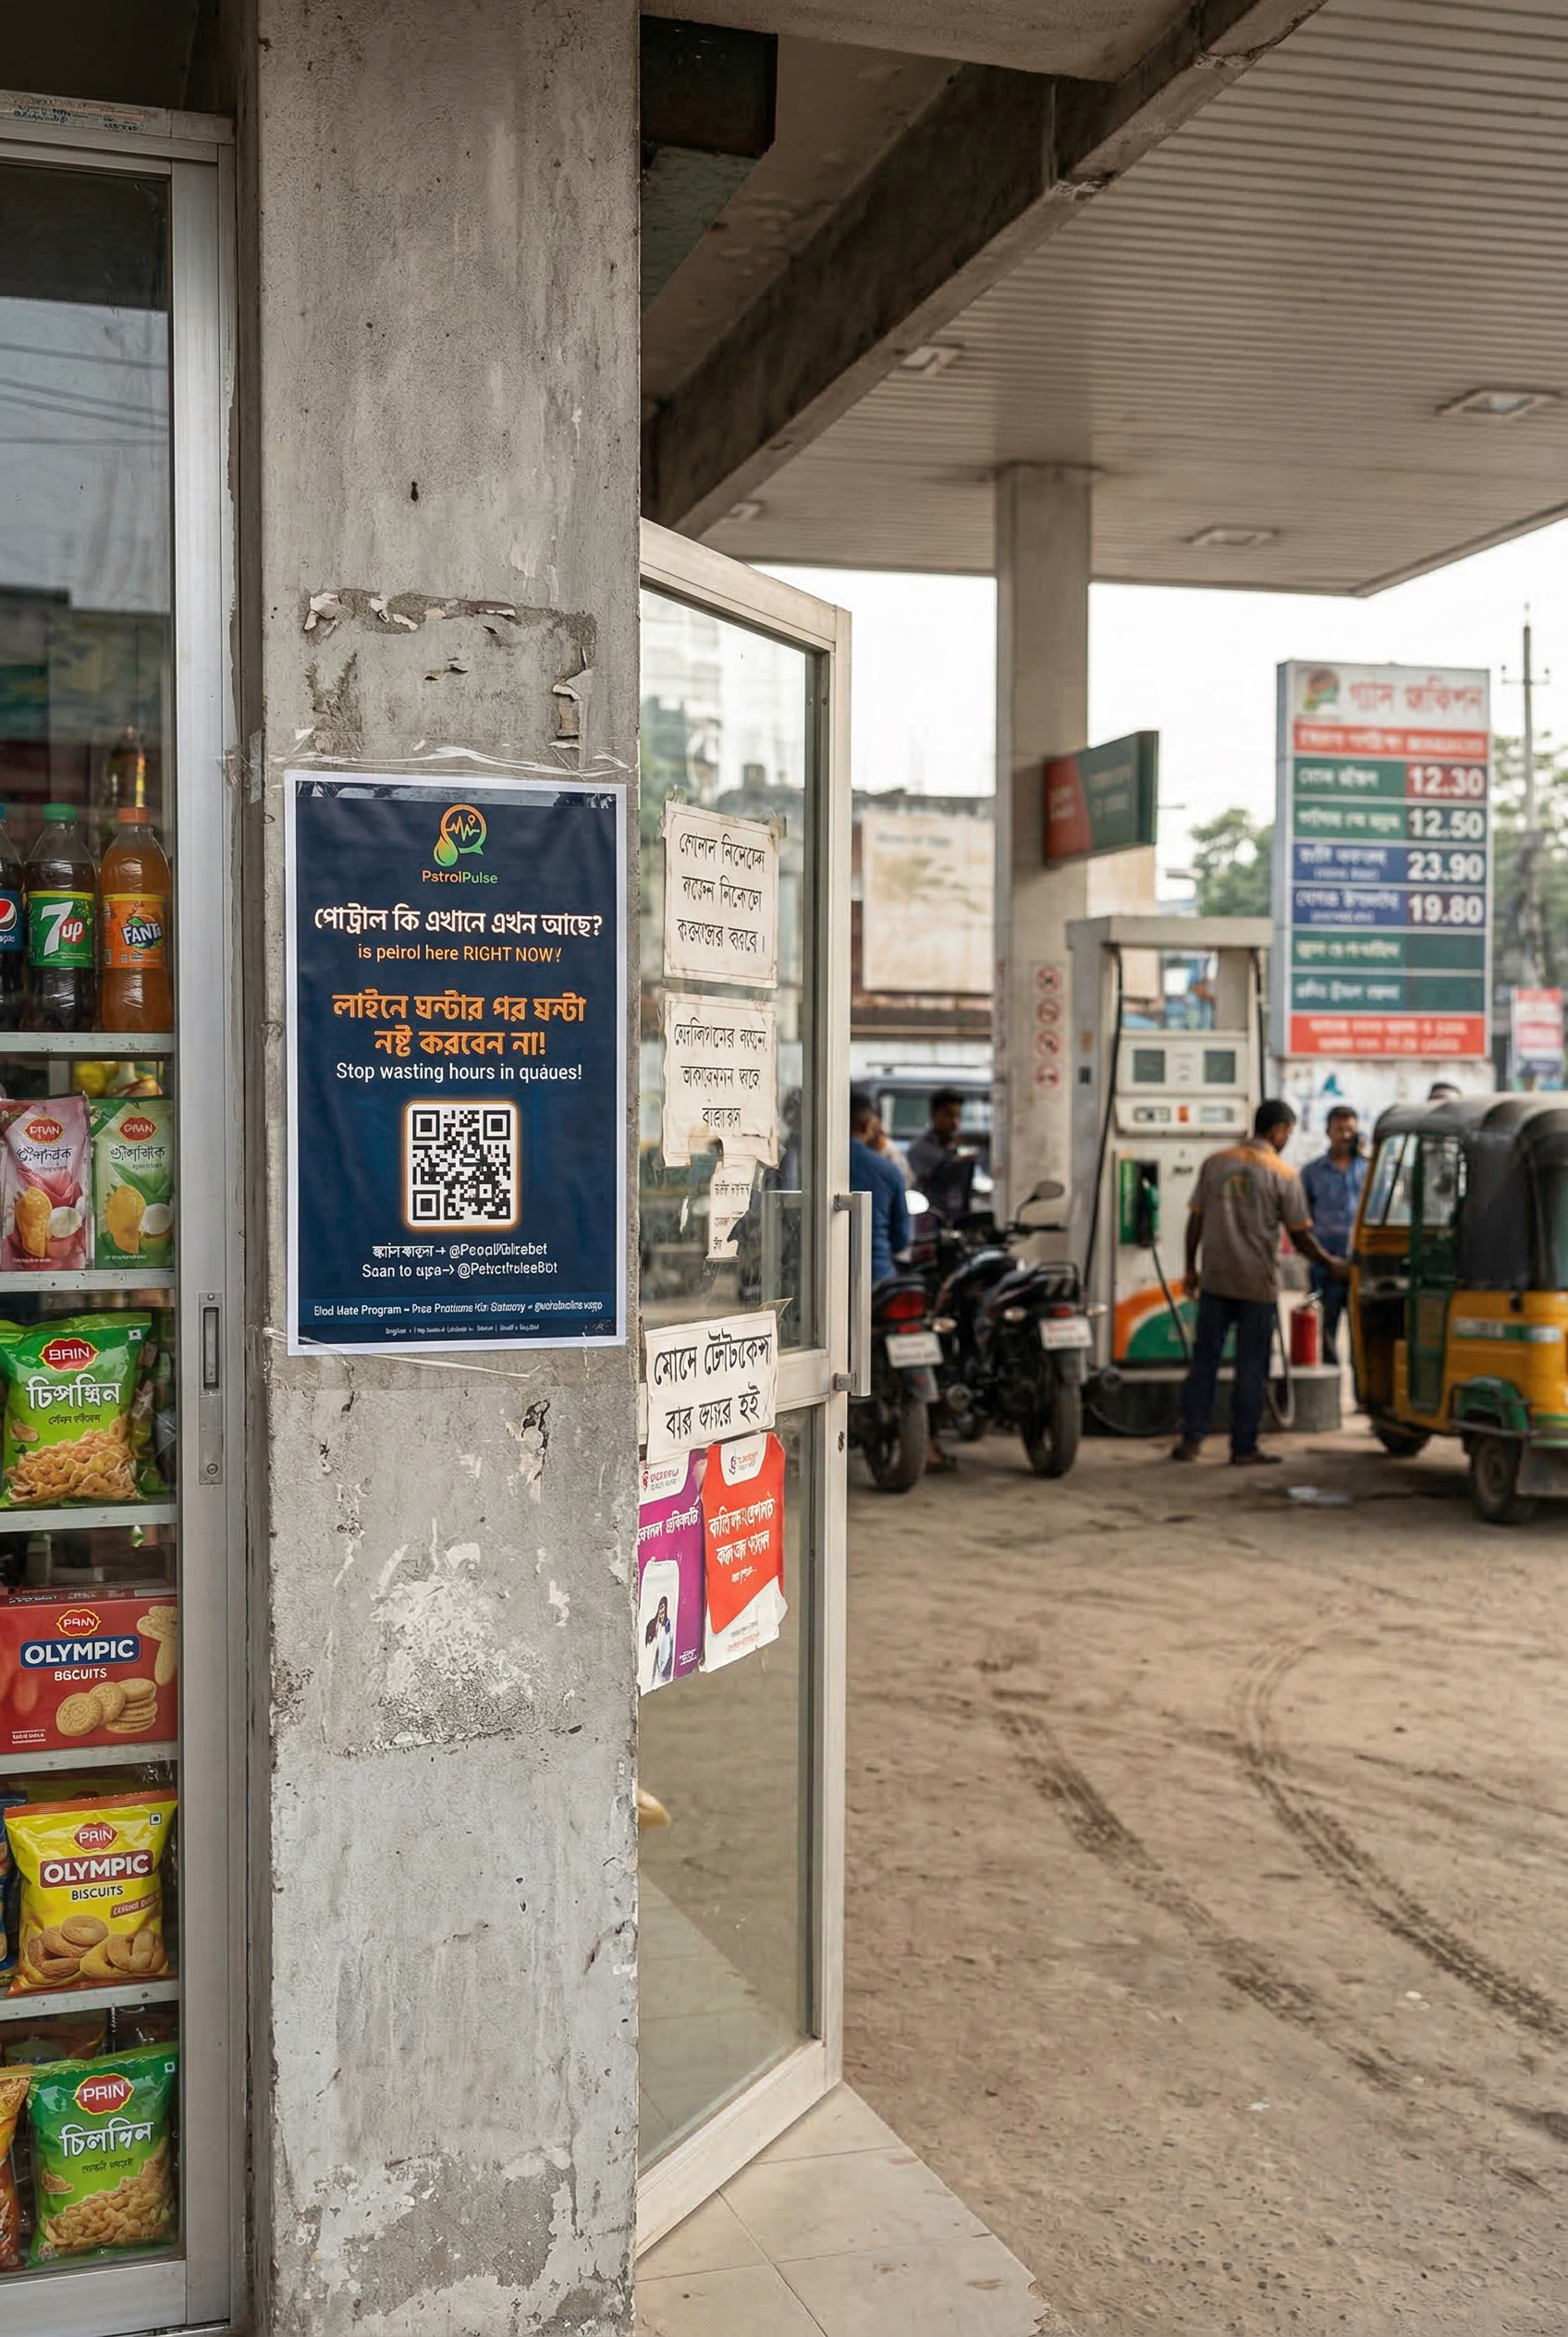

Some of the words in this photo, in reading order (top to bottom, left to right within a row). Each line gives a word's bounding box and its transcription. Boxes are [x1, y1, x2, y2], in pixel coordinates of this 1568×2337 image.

[1408, 765, 1485, 797] 12.30
[1408, 808, 1484, 839] 12.50
[1407, 851, 1484, 883] 23.90
[392, 903, 421, 931] কি
[425, 908, 485, 934] এখানে
[491, 911, 535, 935] এখন
[542, 913, 603, 937] আছে?
[1407, 894, 1484, 924] 19.80
[425, 945, 459, 960] here
[463, 947, 511, 961] RIGHT
[332, 988, 409, 1020] লাইনে
[493, 996, 527, 1022] পর
[419, 1031, 506, 1056] করবেন
[511, 1031, 546, 1056] না!
[337, 1062, 375, 1083] Stop
[380, 1063, 444, 1083] wasting
[449, 1063, 496, 1081] hours
[500, 1063, 514, 1080] in
[399, 1265, 412, 1278] to
[361, 1304, 402, 1317] Program
[25, 1639, 134, 1664] OLYMPIC
[43, 1854, 150, 1883] OLYMPIC
[71, 1886, 124, 1900] BISCUITS
[83, 2084, 125, 2102] PRIN
